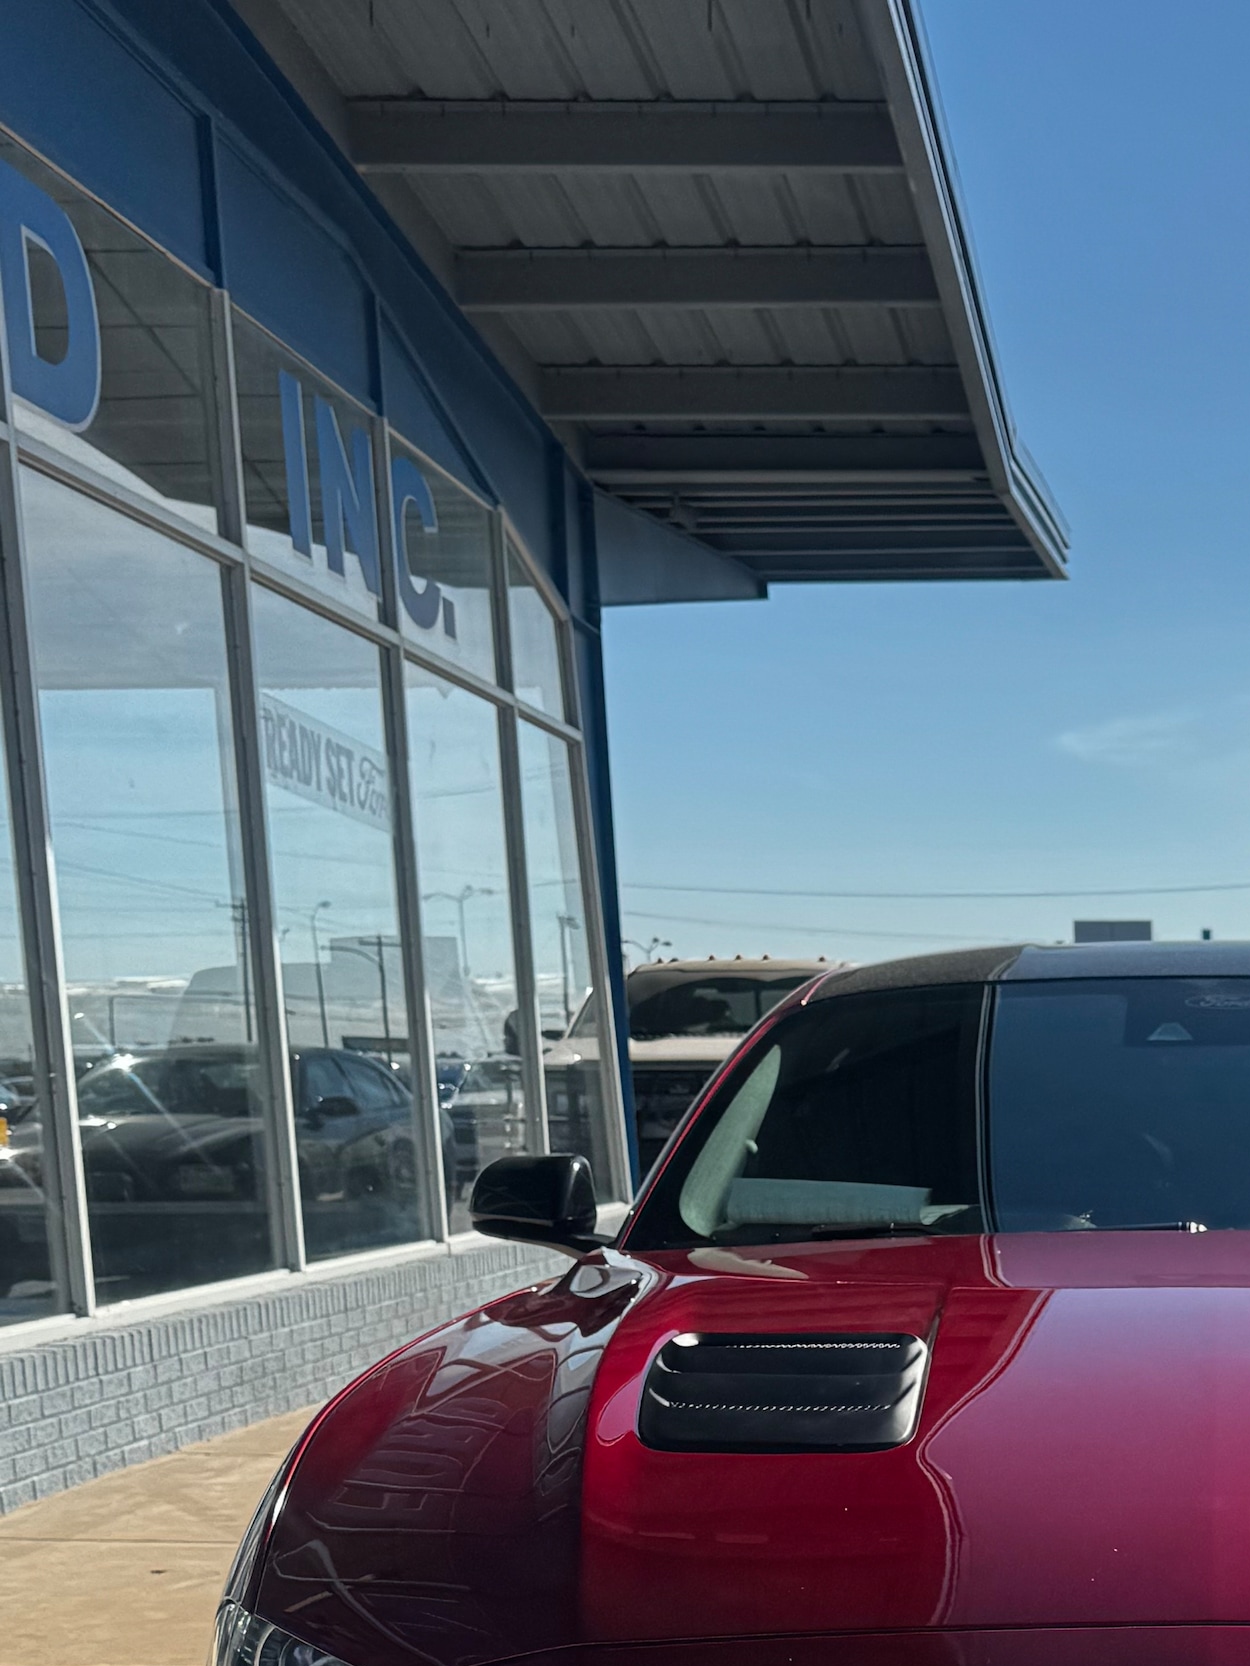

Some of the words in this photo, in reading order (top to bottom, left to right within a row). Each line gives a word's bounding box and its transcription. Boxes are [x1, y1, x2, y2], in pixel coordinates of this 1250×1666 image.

[279, 367, 457, 641] INC.
[262, 704, 322, 792] READY
[325, 737, 355, 807] SET
